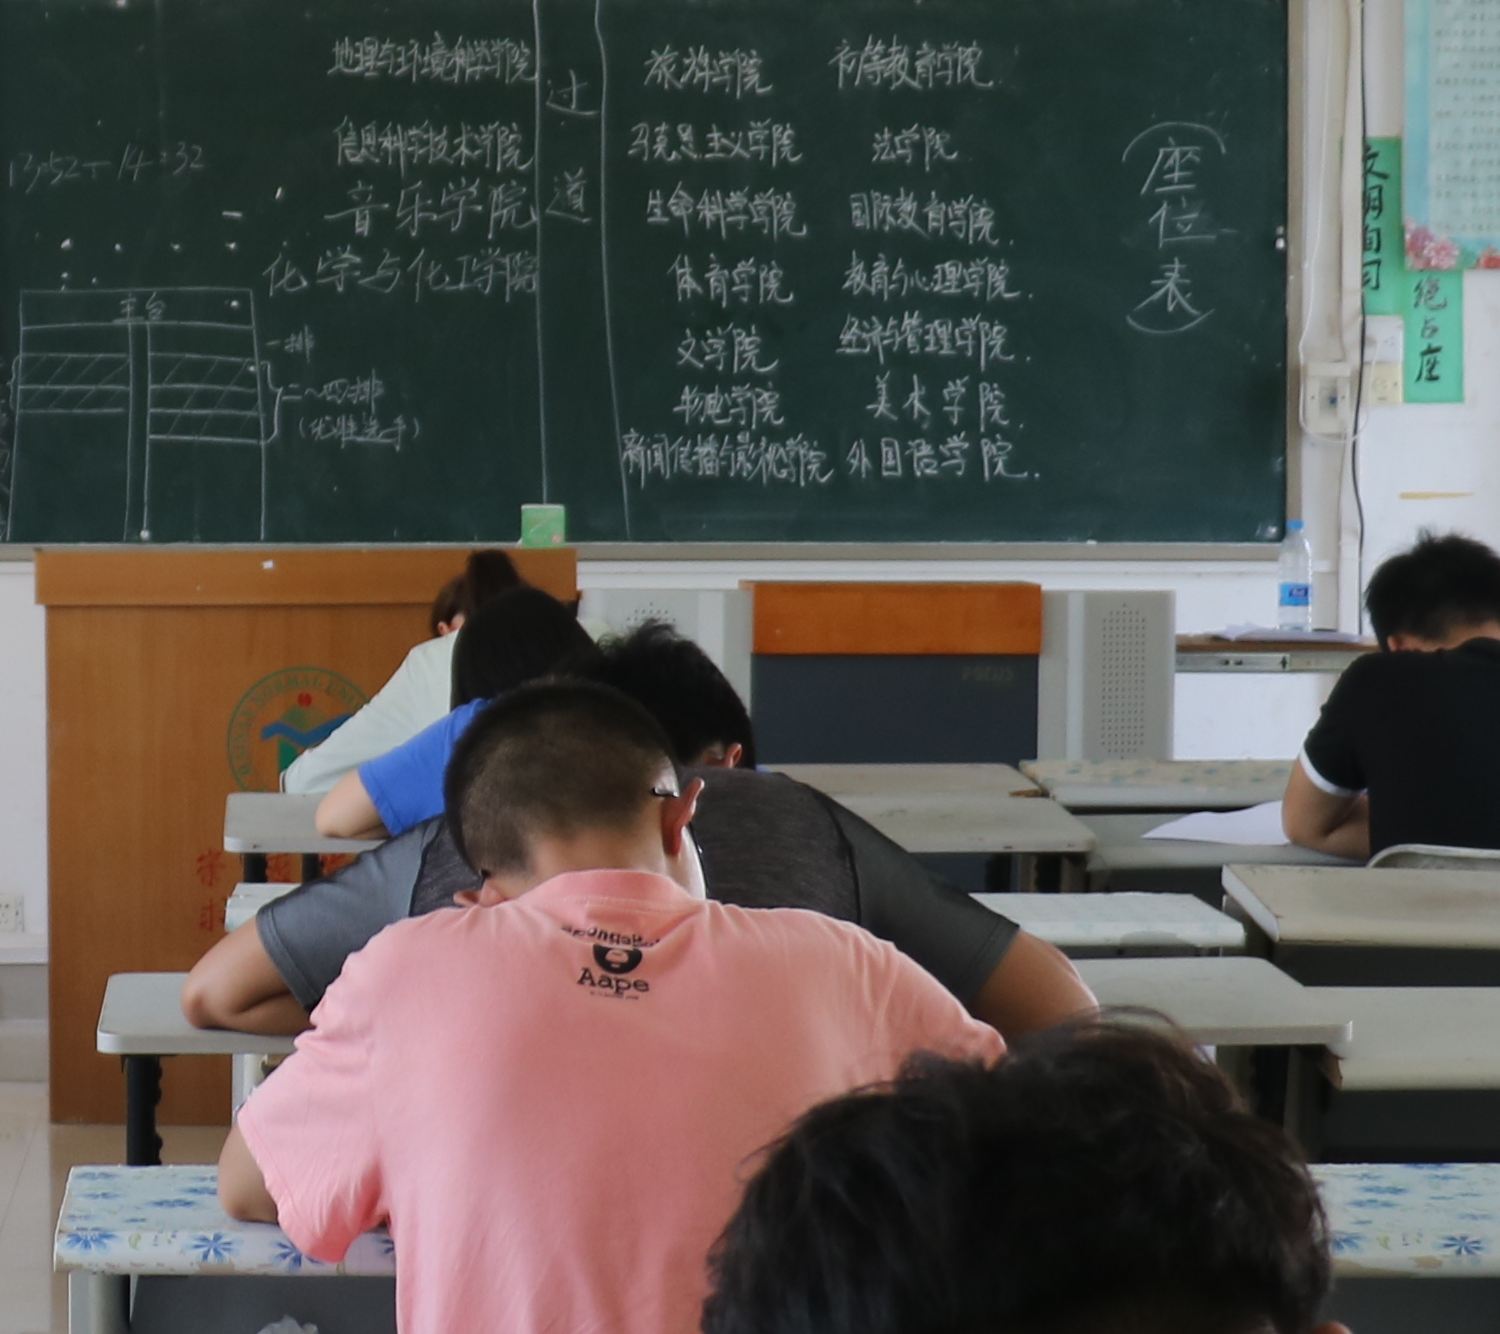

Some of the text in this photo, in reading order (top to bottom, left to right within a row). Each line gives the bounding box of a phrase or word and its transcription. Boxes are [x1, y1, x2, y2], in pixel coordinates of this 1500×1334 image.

[333, 116, 535, 175] 信息科学技术学院
[628, 118, 803, 167] 马克思主义学院
[871, 123, 958, 171] 法学院
[324, 177, 538, 238] 音乐学院
[647, 182, 807, 243] 生命科学学院
[263, 244, 538, 303] 化学与化工学院
[667, 253, 793, 307] 体育学院
[677, 322, 779, 374] 文学院
[1412, 269, 1448, 383] 绝占座
[577, 968, 650, 995] Aape
